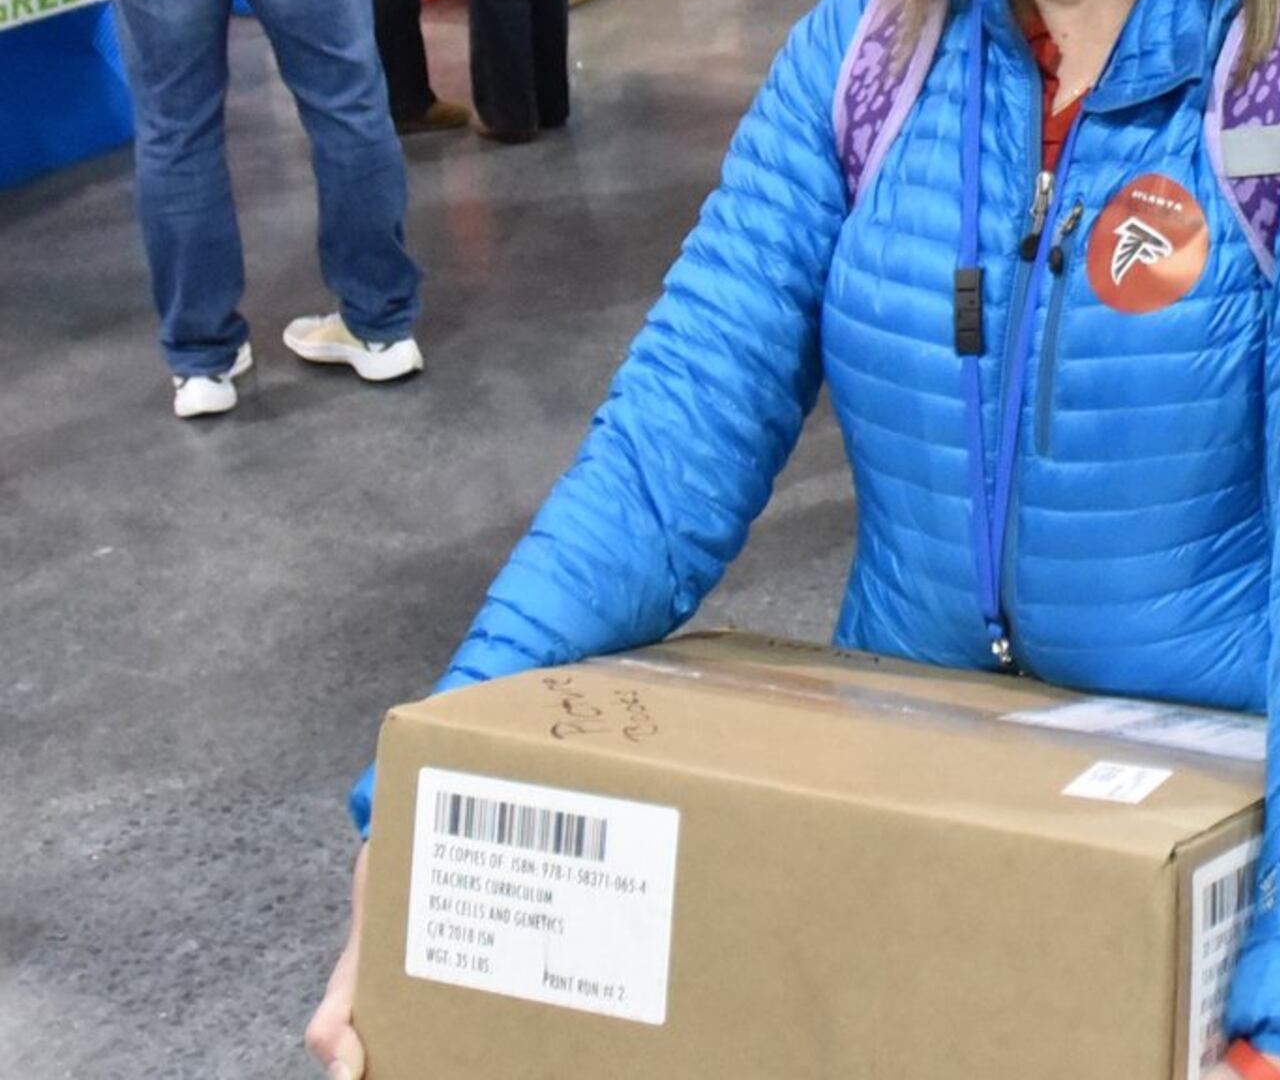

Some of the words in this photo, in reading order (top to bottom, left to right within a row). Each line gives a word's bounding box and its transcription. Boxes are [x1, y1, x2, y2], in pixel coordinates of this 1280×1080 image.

[449, 845, 486, 867] COPIES
[489, 852, 504, 869] OF
[431, 869, 481, 893] TEACHERS
[485, 878, 553, 905] CURRICULUM
[455, 899, 486, 920] CELLS
[489, 906, 512, 926] AND
[514, 908, 565, 936] GENETICS
[448, 923, 475, 944] 2018
[542, 970, 574, 994] PRINT
[577, 978, 600, 998] RUN
